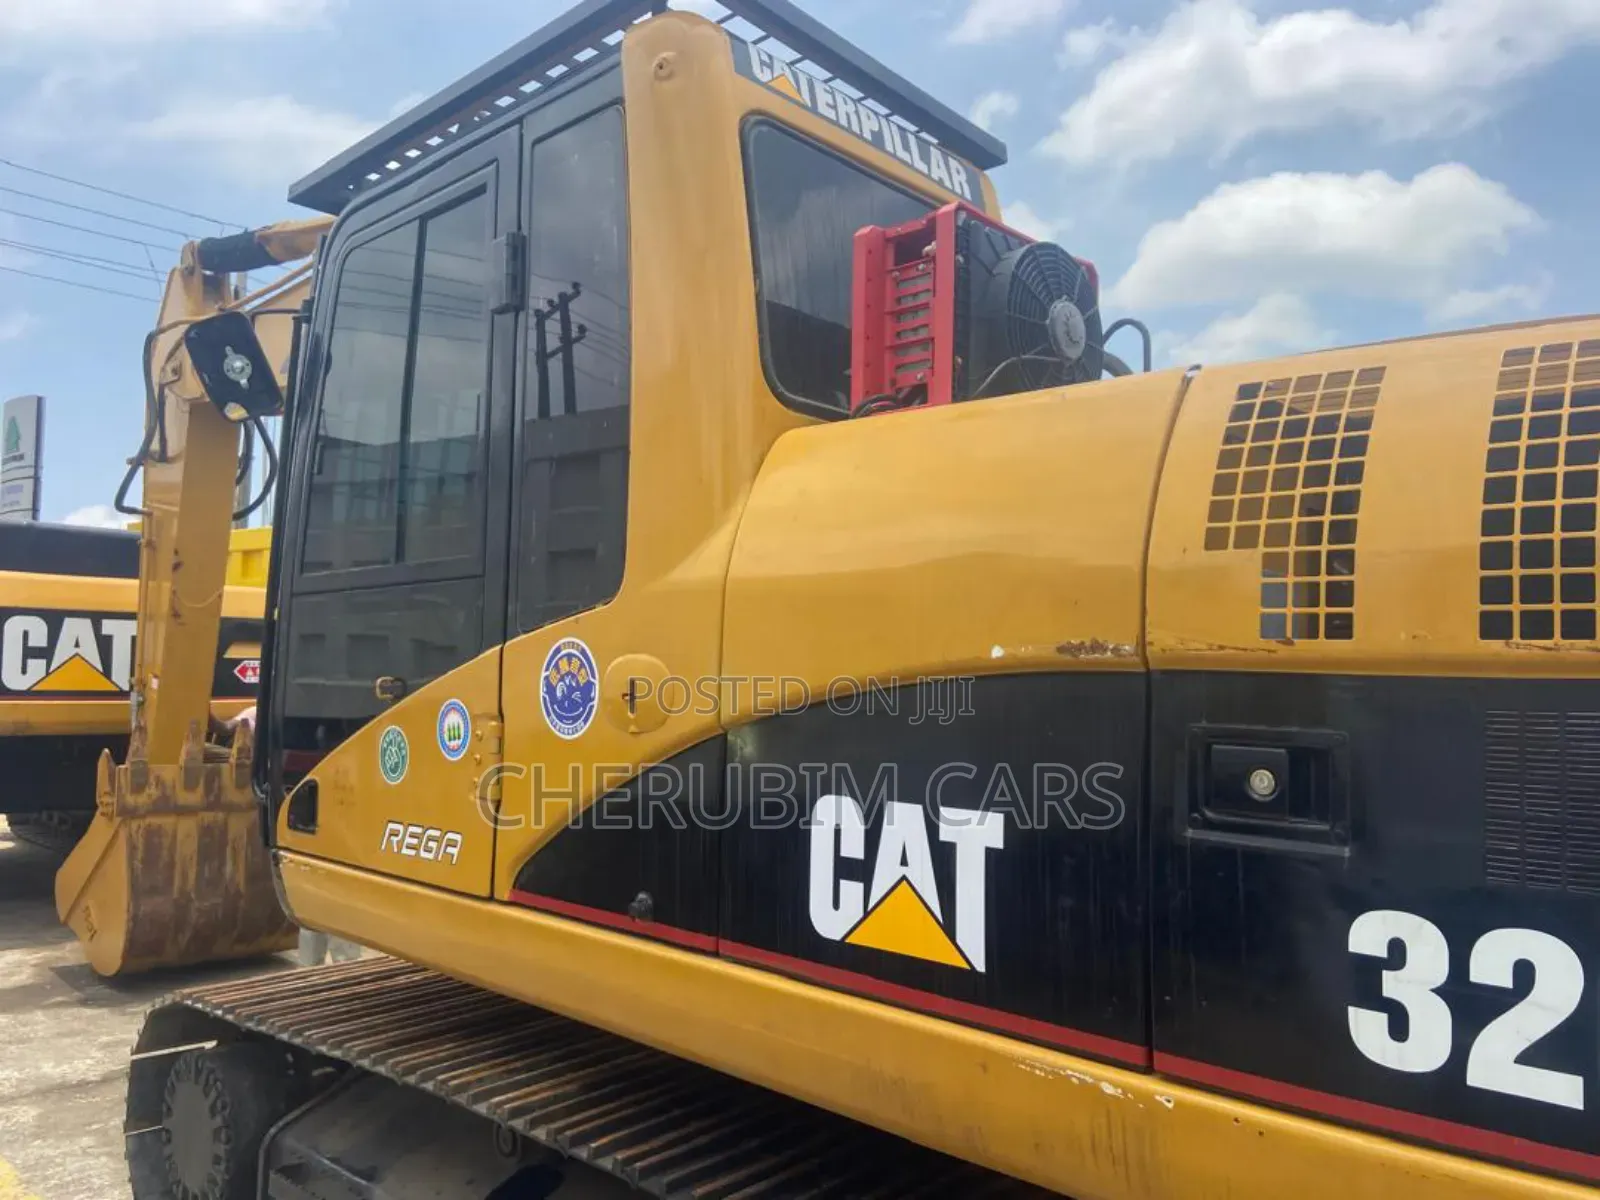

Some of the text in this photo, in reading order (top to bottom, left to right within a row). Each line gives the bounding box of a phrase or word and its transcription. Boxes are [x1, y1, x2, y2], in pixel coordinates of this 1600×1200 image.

[748, 42, 972, 201] CATERPILLAR
[1, 615, 136, 692] CAT
[380, 820, 463, 865] REGA
[809, 793, 1005, 973] CAT
[1347, 909, 1585, 1112] 32
